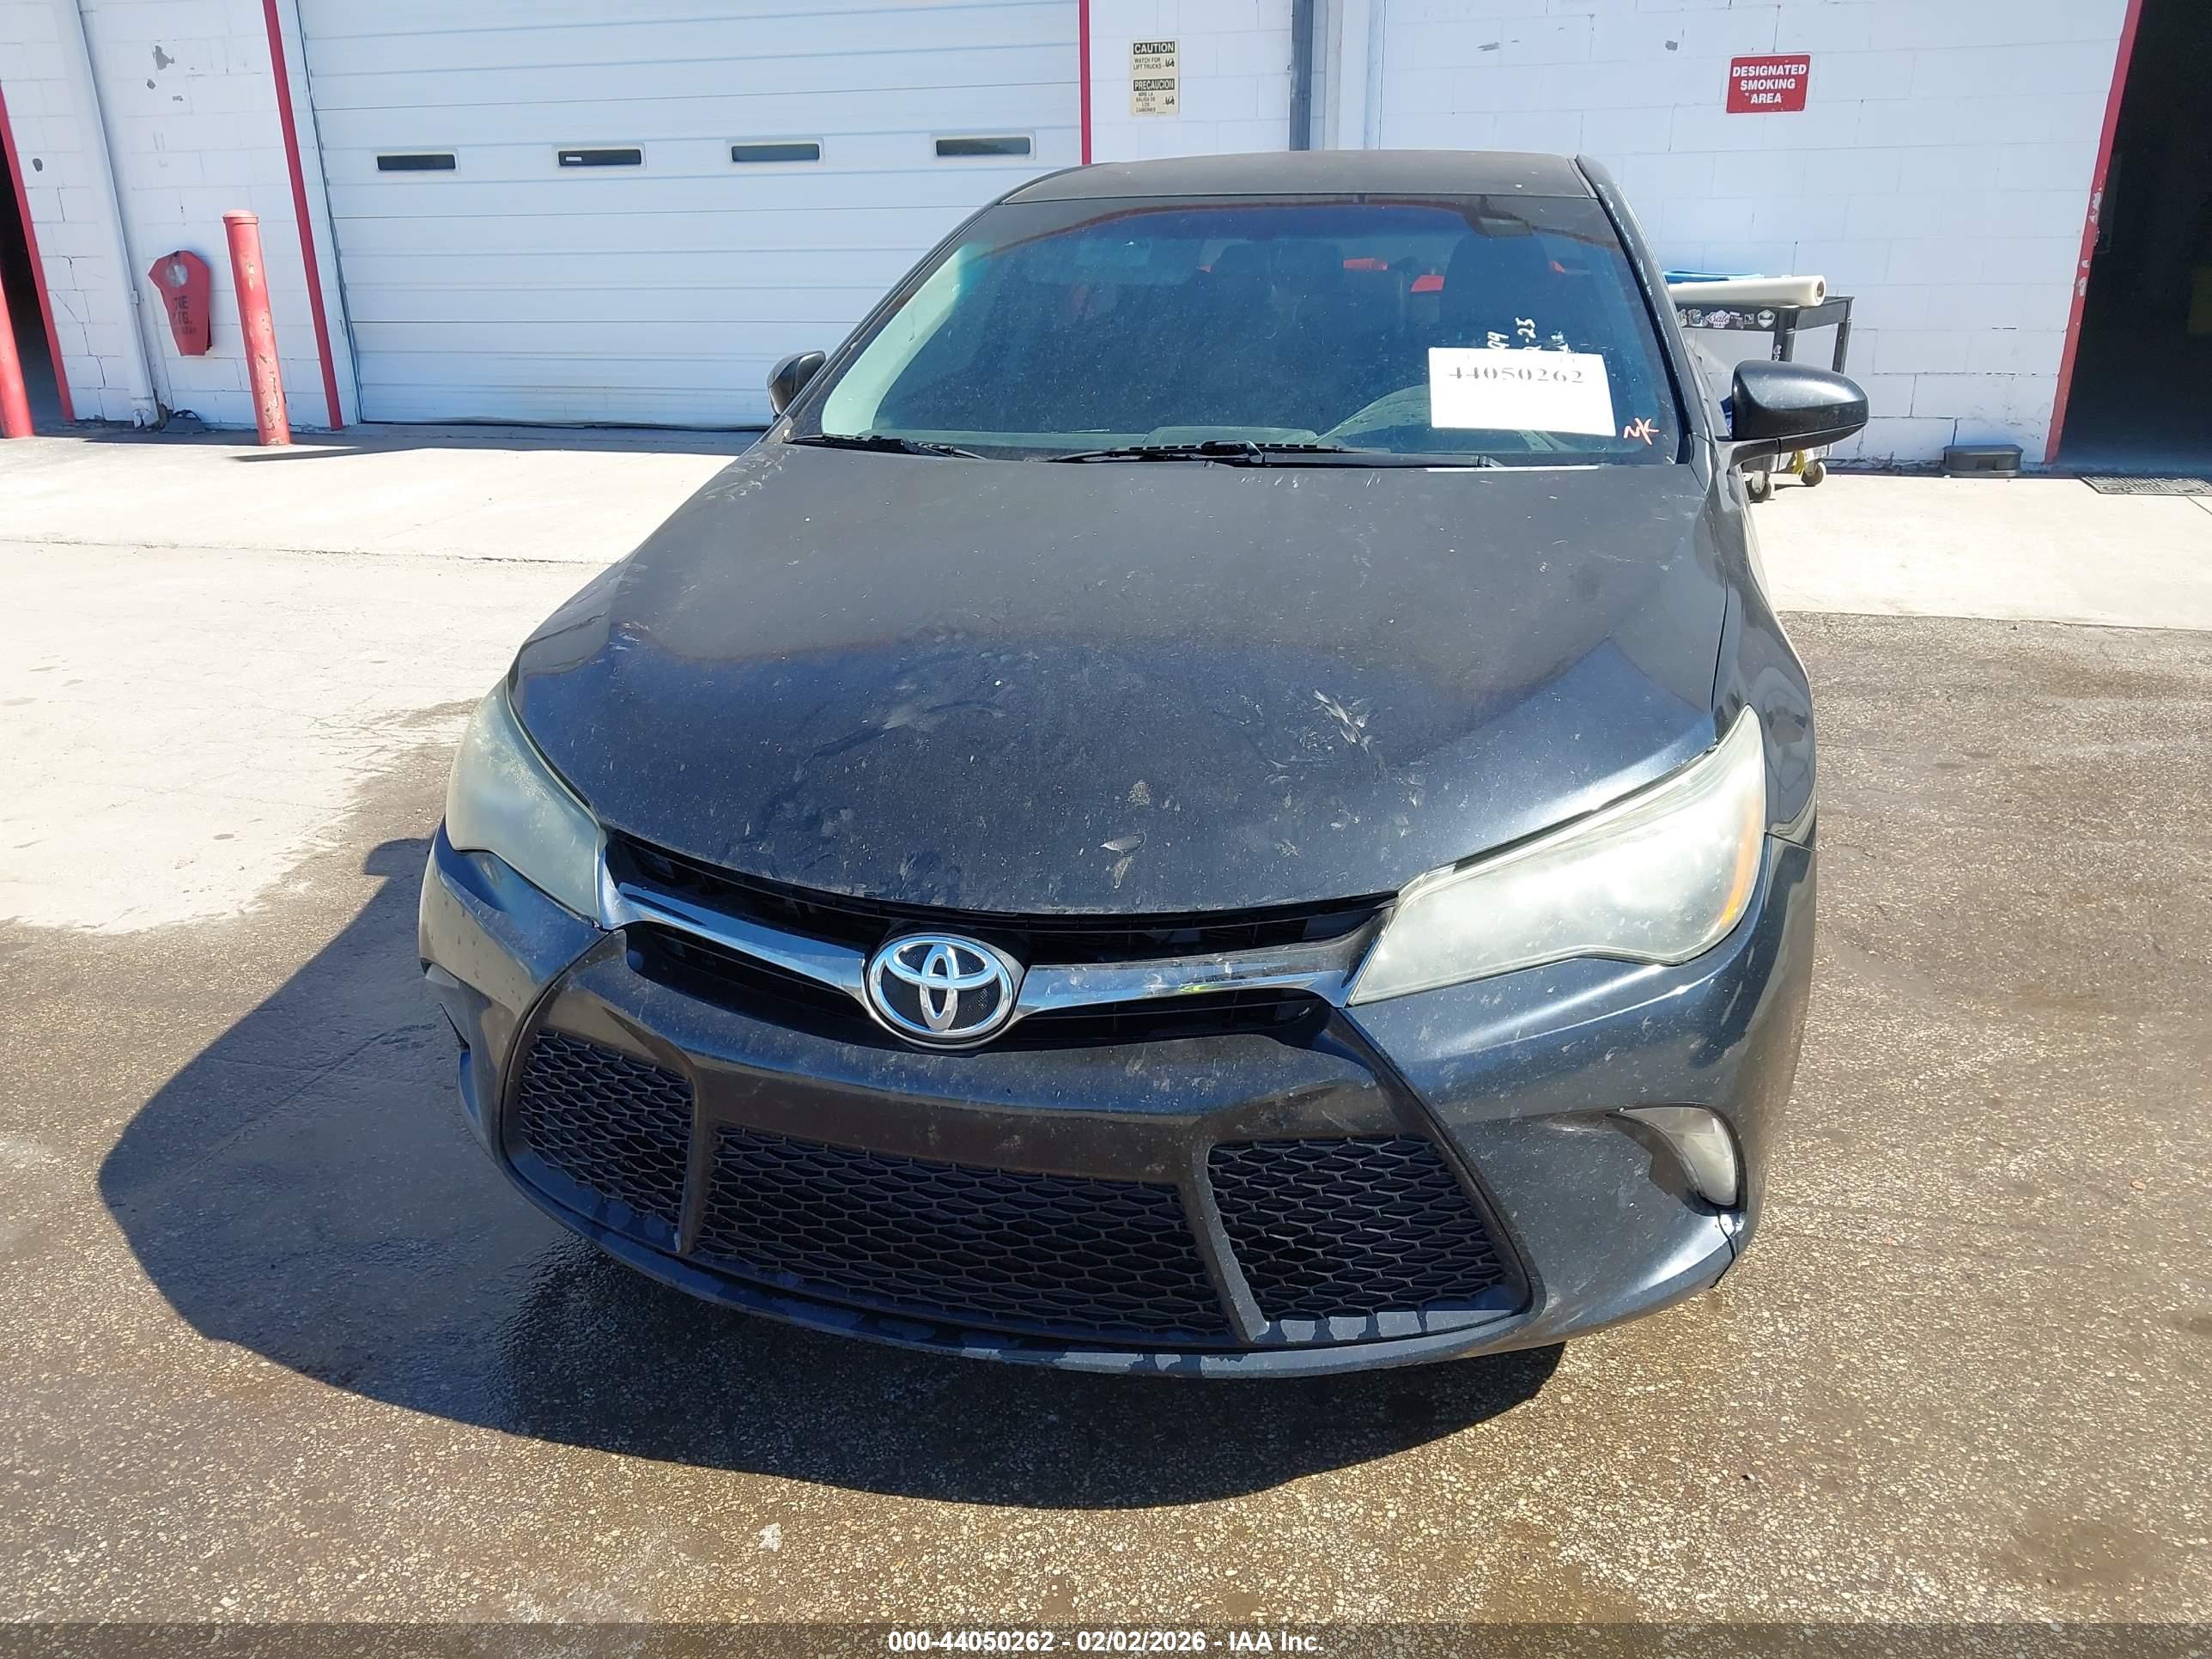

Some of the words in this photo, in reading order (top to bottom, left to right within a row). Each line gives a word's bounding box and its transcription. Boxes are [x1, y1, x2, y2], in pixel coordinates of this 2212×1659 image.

[1134, 42, 1174, 53] CAUTION
[1732, 64, 1808, 77] DESIGNATED
[1740, 78, 1796, 91] SMOKING
[1750, 93, 1783, 104] AREA
[1449, 367, 1583, 384] 44050262
